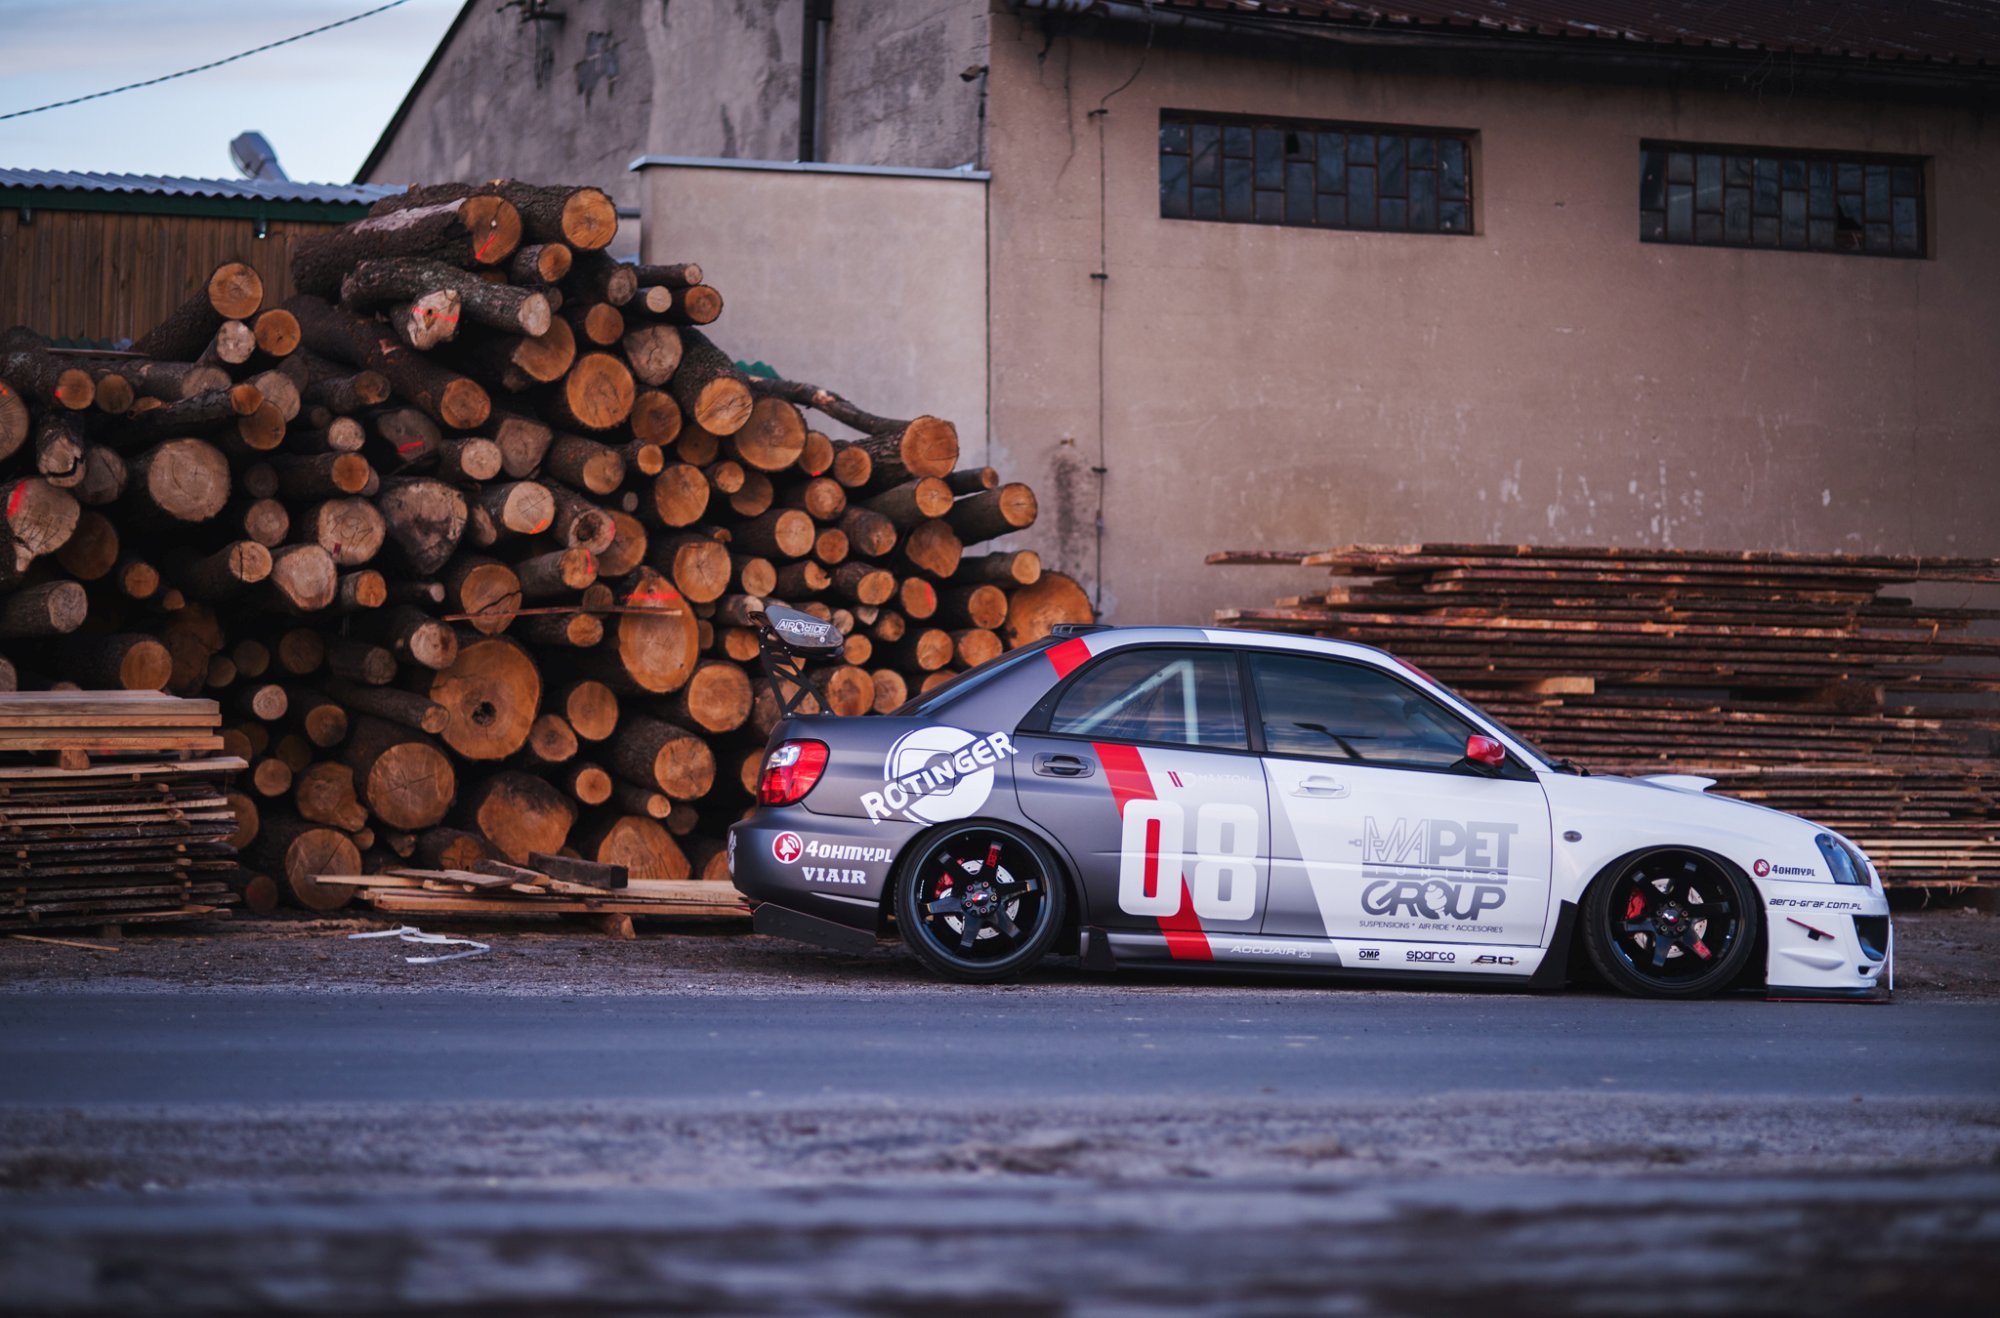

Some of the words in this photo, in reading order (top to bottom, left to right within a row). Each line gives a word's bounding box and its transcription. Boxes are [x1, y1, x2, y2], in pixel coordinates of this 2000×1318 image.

[860, 731, 1019, 825] ROTINGER
[1362, 815, 1519, 868] MAPET
[1118, 798, 1259, 921] 08
[802, 866, 866, 884] VIAIR
[1361, 879, 1507, 920] GROUP
[1359, 920, 1410, 930] SUSPENSIONS
[1418, 922, 1431, 930] AIR
[1432, 923, 1449, 931] RIDE
[1456, 924, 1504, 934] ACCESORIES
[1230, 945, 1297, 955] ACCUAIR
[1359, 949, 1380, 960] OMP
[1406, 950, 1456, 963] sparco
